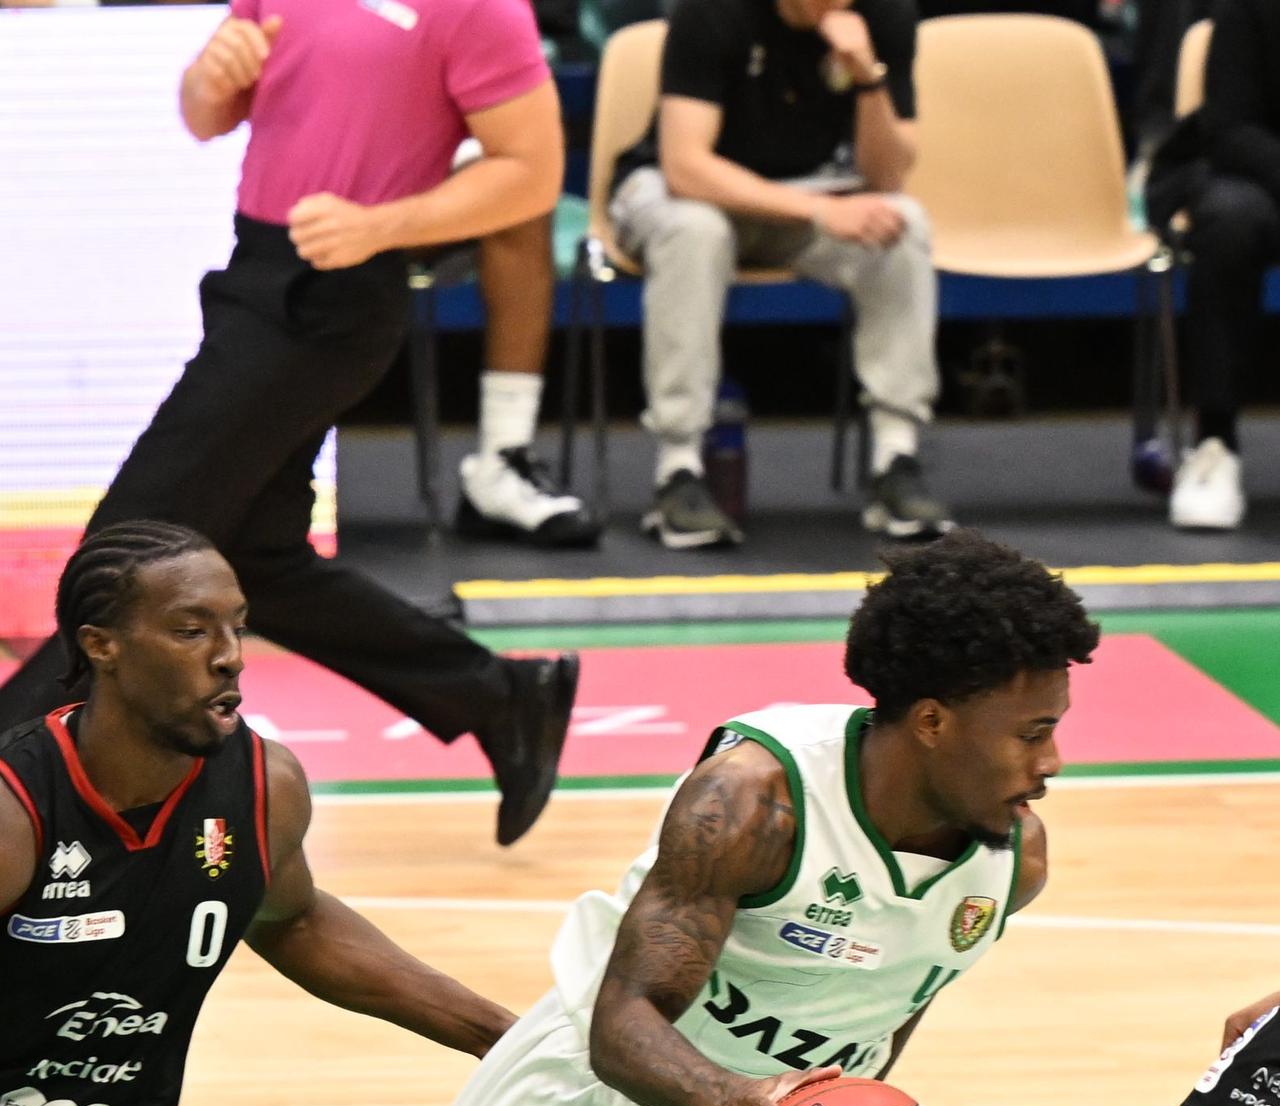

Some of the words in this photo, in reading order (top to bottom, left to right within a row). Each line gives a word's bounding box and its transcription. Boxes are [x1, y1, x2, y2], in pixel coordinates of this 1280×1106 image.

[16, 922, 58, 938] PGE
[186, 900, 229, 968] 0
[56, 1011, 169, 1042] Enea
